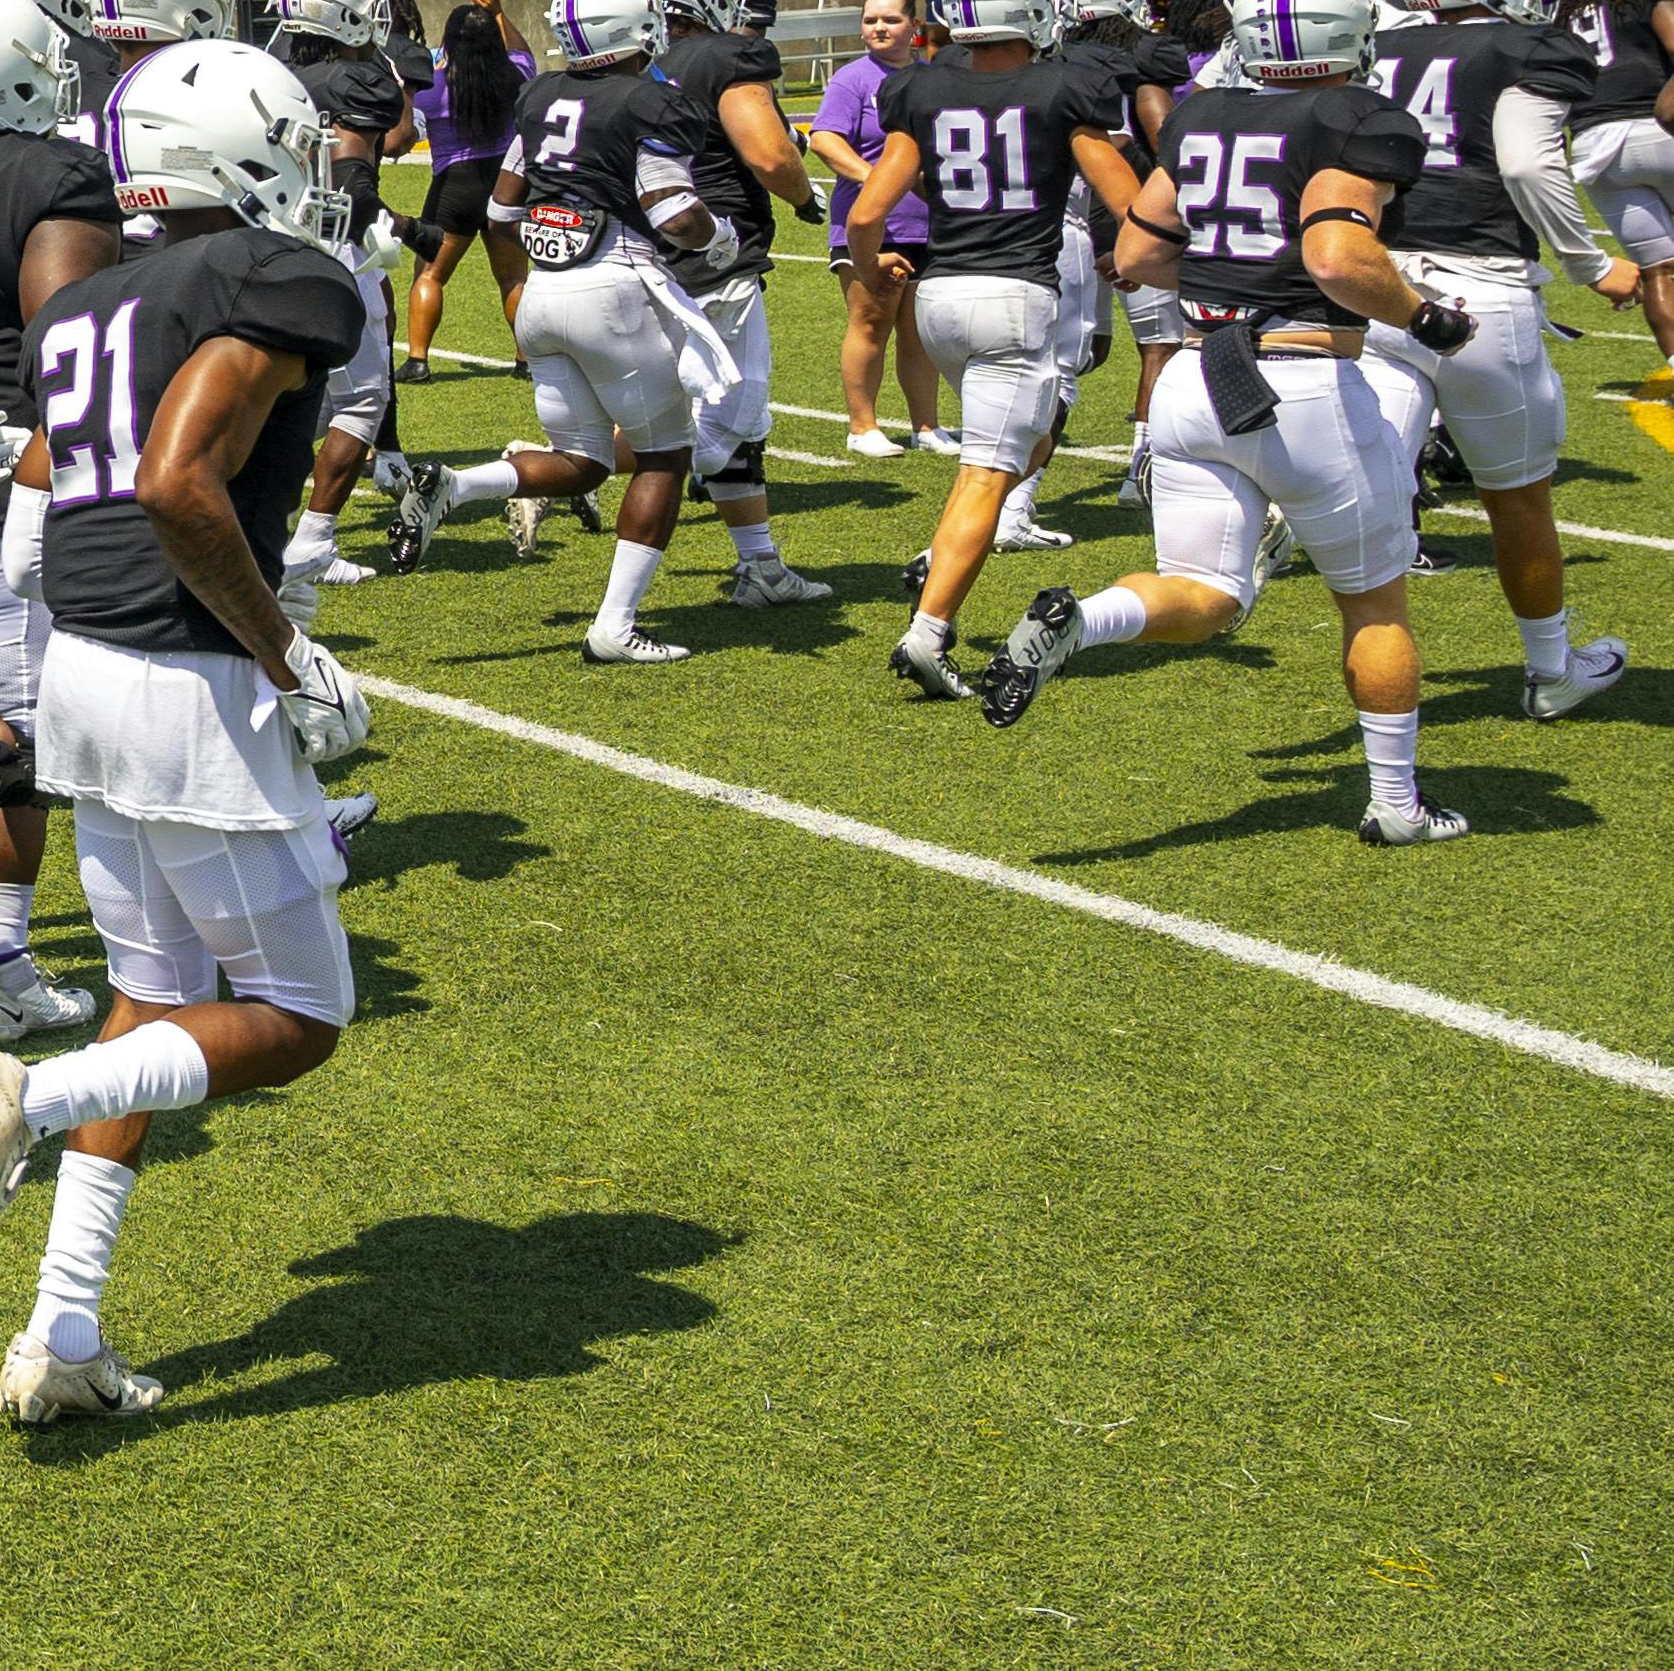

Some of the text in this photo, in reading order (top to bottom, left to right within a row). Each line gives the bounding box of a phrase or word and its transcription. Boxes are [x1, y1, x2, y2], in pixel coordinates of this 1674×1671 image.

[93, 24, 147, 40] Riddell
[570, 53, 617, 71] Riddell
[1260, 62, 1330, 79] Riddell
[534, 97, 583, 171] 2
[932, 106, 1039, 211] 81
[1176, 132, 1289, 259] 25
[536, 208, 574, 225] DANGER
[524, 234, 560, 259] DOG
[40, 297, 143, 507] 21
